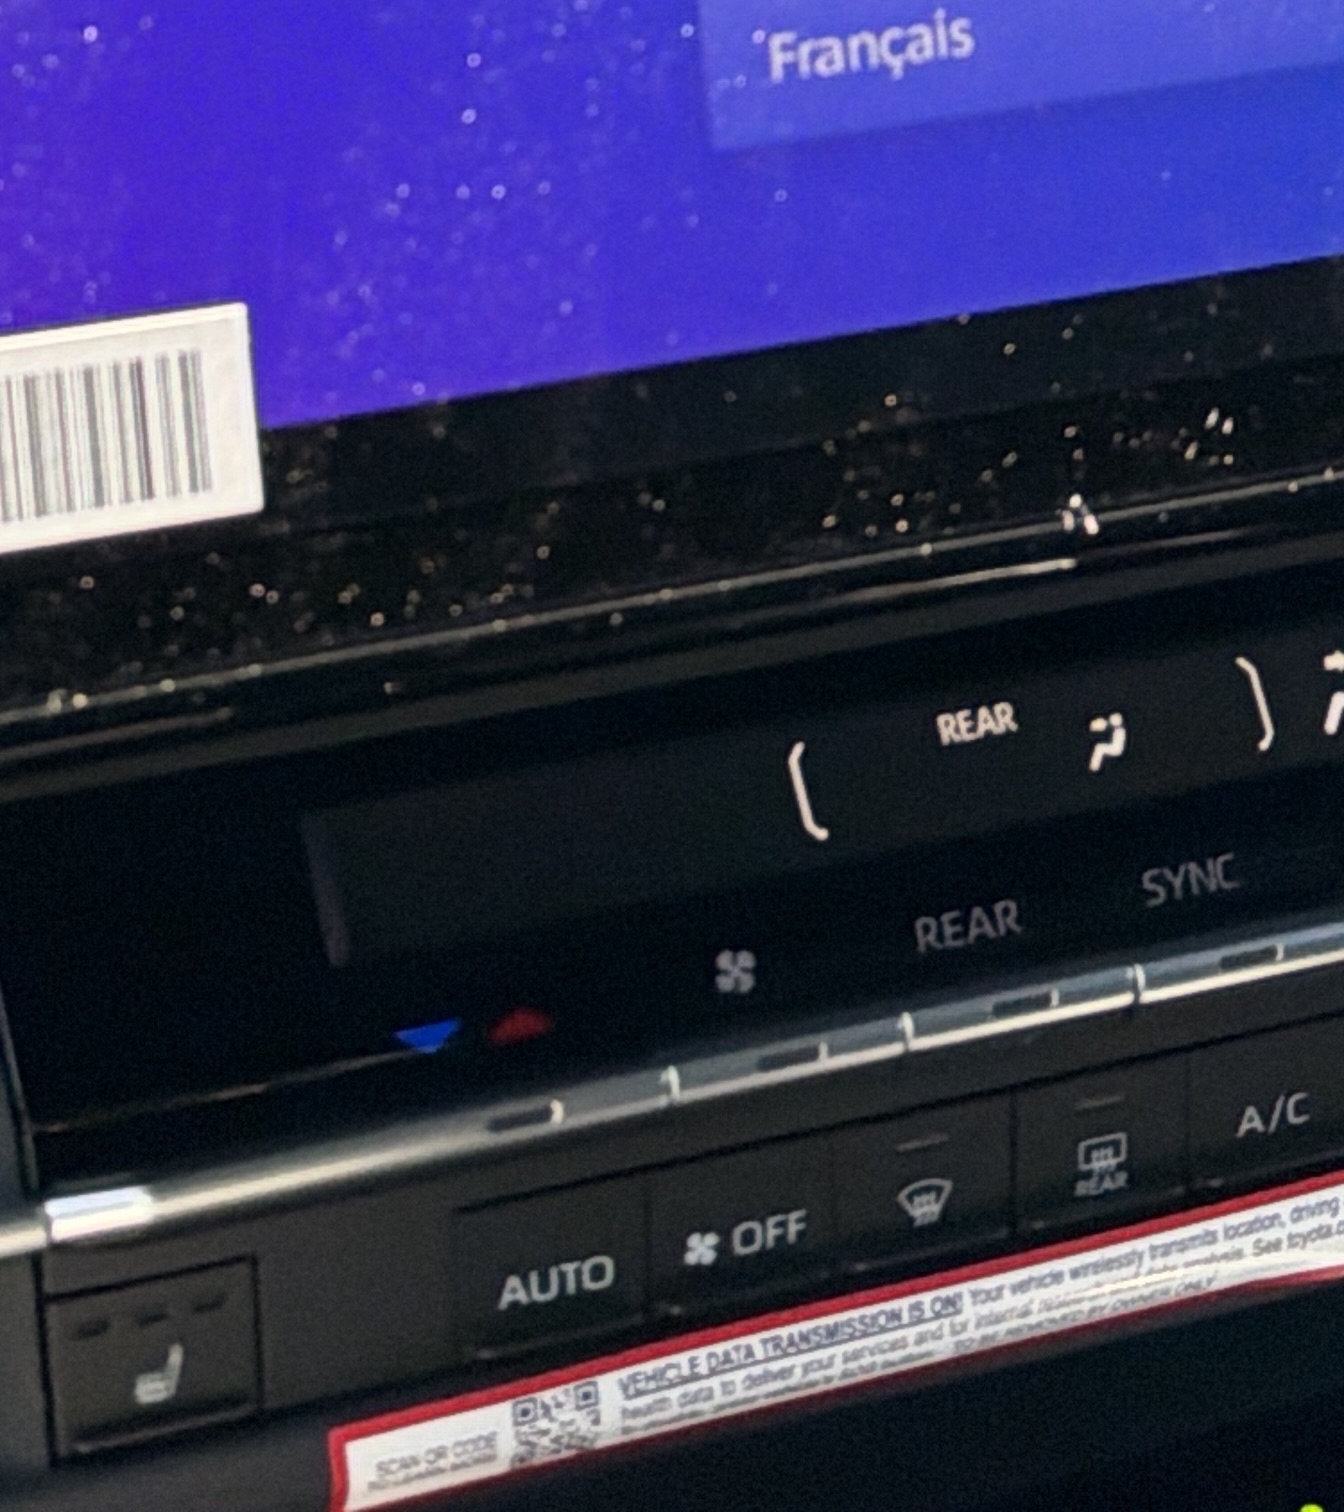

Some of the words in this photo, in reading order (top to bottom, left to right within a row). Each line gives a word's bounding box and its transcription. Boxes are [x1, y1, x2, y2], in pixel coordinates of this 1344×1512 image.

[768, 9, 975, 83] Français
[936, 701, 1018, 746] REAR
[1141, 852, 1240, 909] SYNC
[914, 899, 1023, 954] REAR
[1236, 1092, 1310, 1138] A/C
[731, 1209, 807, 1257] OFF
[498, 1255, 616, 1310] AUTO
[617, 1355, 701, 1396] VEHICLE
[705, 1343, 757, 1371] DATA
[759, 1305, 903, 1356] TRANSMISSION
[907, 1300, 926, 1322] IS
[1289, 1195, 1340, 1225] driving
